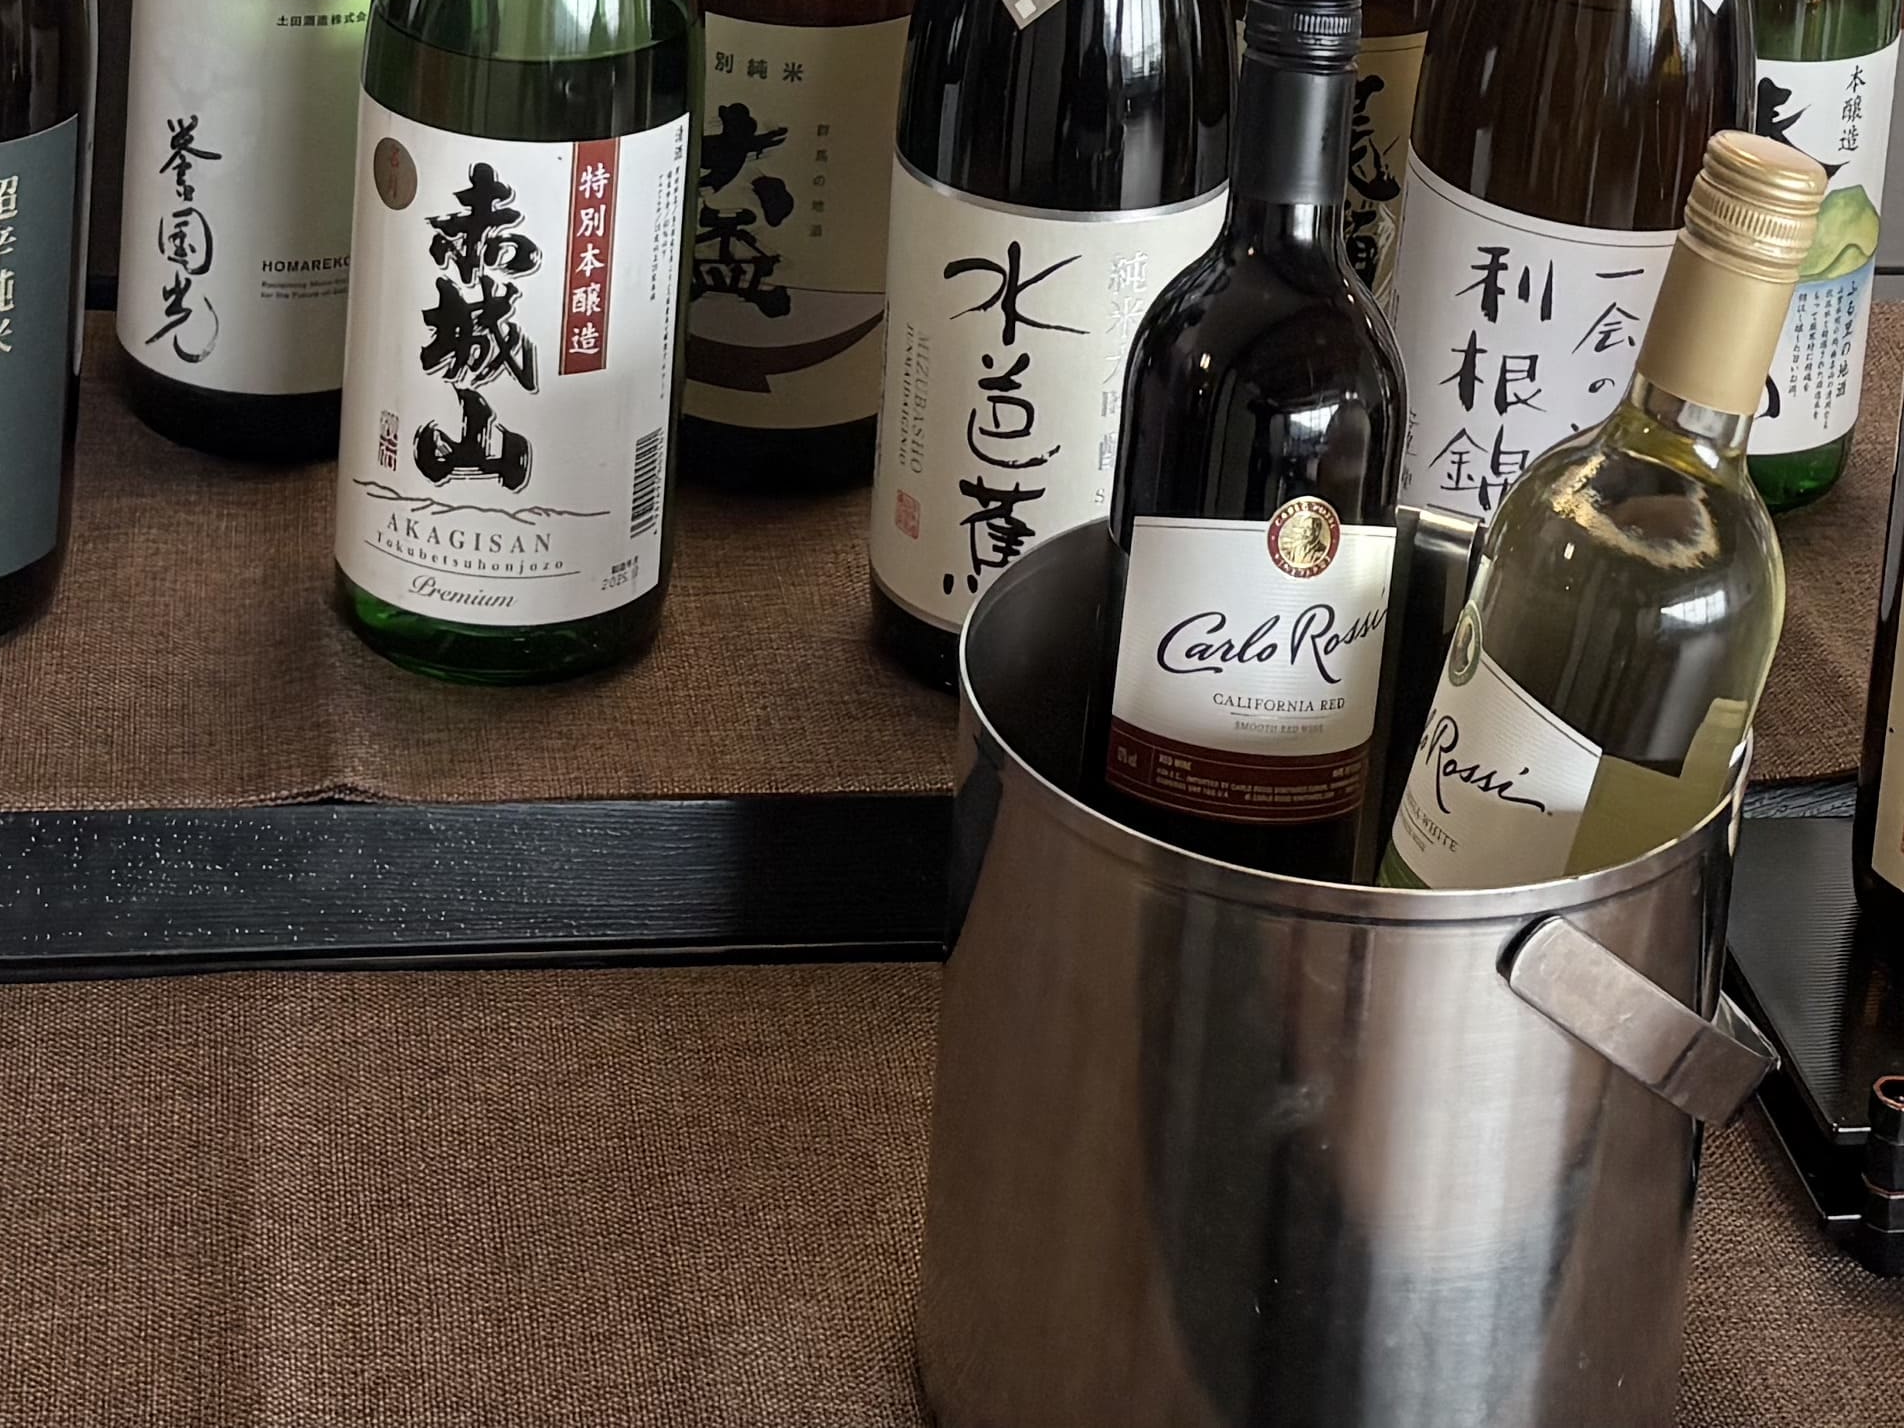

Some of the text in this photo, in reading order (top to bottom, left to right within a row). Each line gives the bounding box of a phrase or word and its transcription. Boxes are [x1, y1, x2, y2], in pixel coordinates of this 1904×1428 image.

[1837, 64, 1868, 152] 本醸造
[568, 163, 611, 356] 特別本醸造
[412, 162, 543, 494] 赤城山
[387, 511, 552, 554] AKAGISAN
[408, 574, 518, 608] Premium
[1157, 611, 1280, 674] Carlo
[1213, 692, 1346, 713] CALIFORNIA RED
[1425, 714, 1554, 816] Rossi
